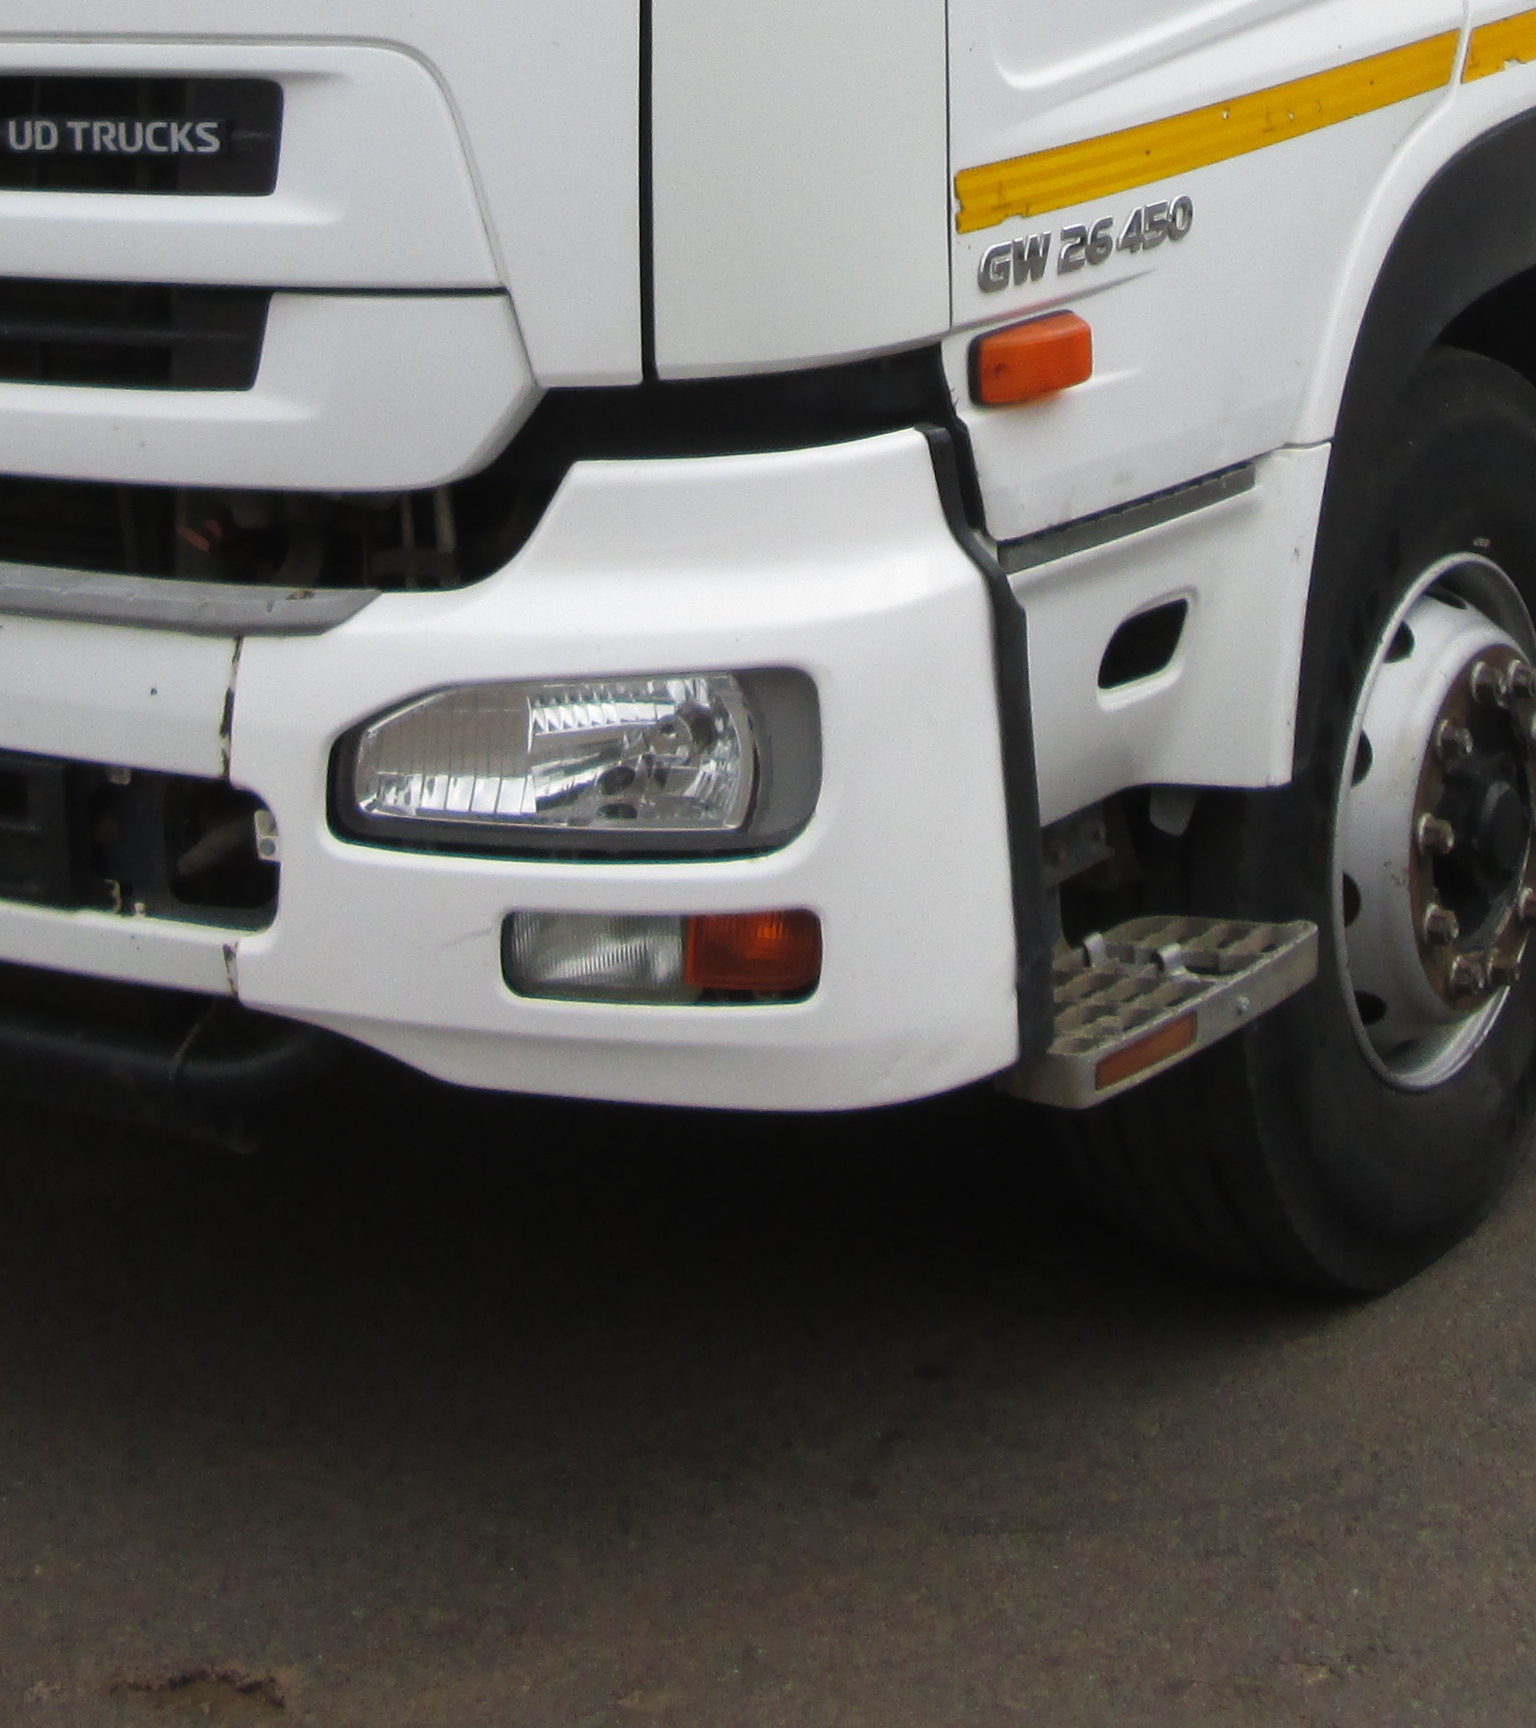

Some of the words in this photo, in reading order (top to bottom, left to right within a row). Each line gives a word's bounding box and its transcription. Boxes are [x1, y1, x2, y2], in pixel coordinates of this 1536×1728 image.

[7, 120, 59, 152] UD
[66, 120, 221, 153] TRUCKS
[976, 230, 1052, 294] GW
[1056, 215, 1114, 276] 26
[1115, 193, 1194, 254] 450
